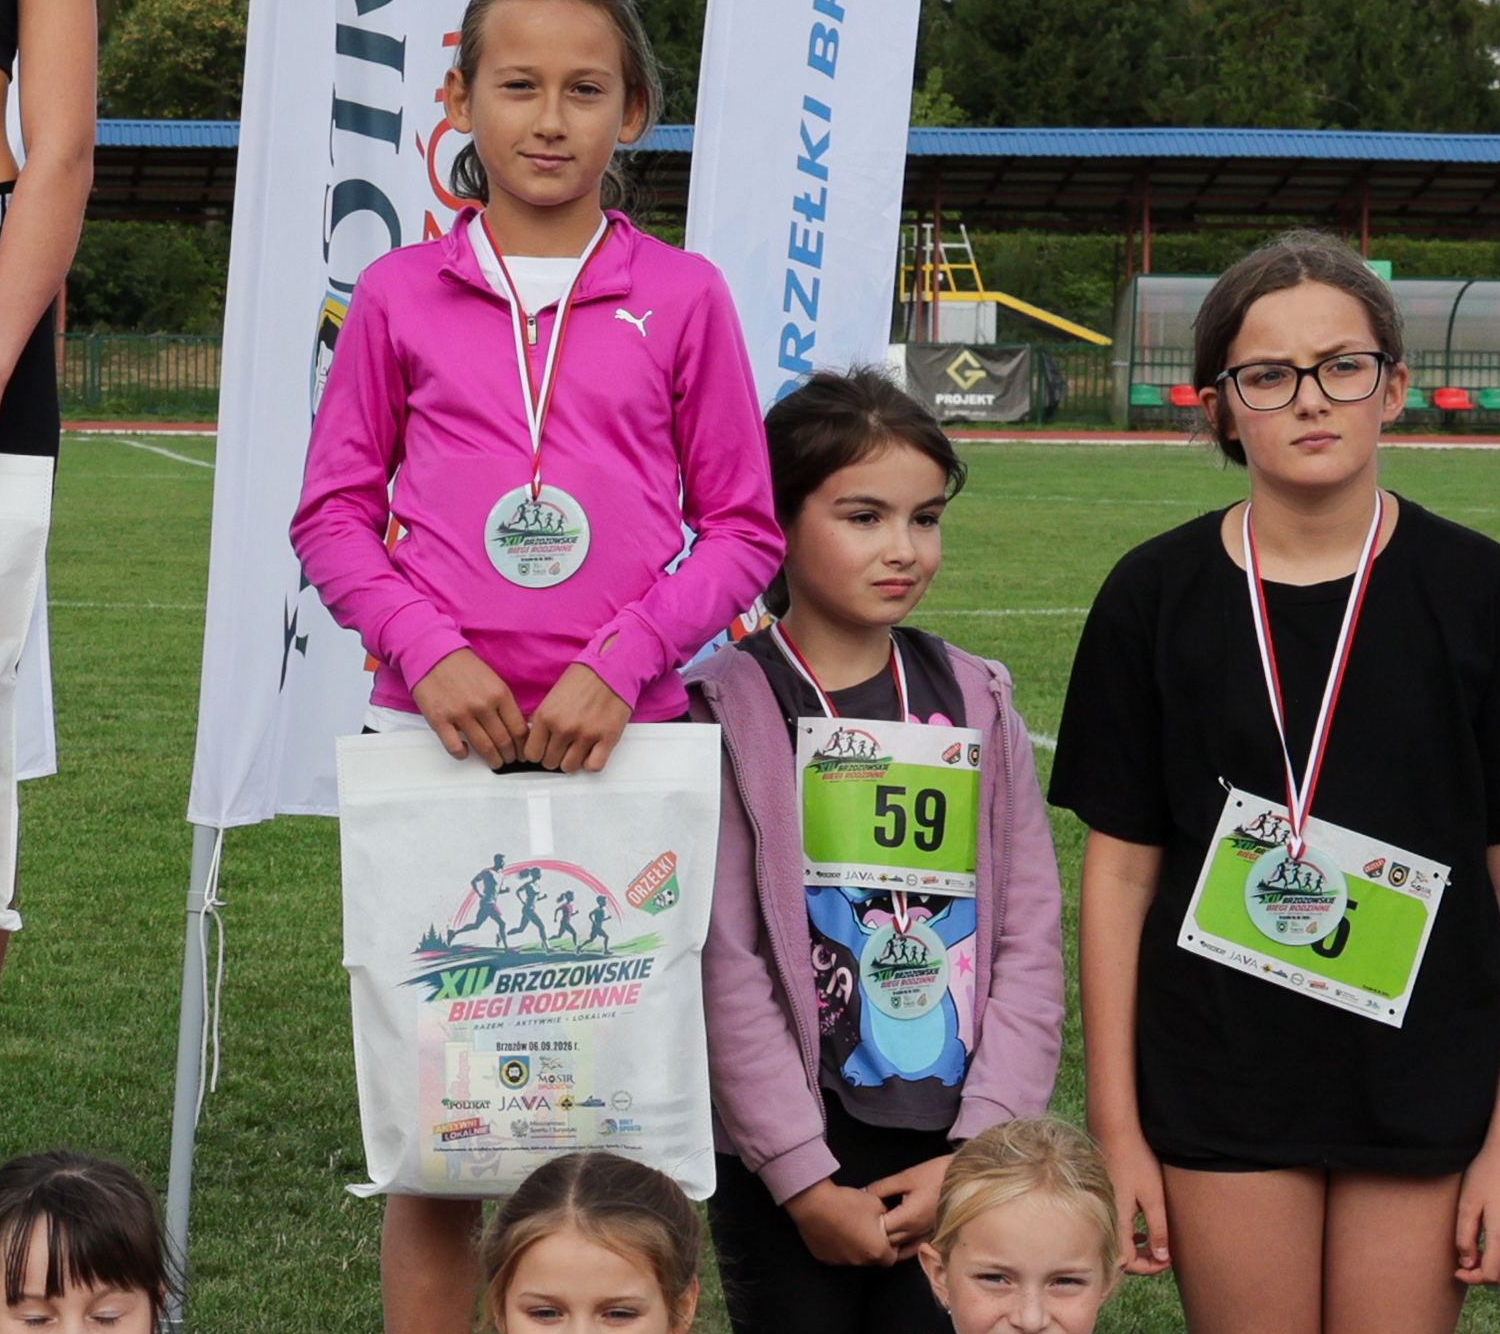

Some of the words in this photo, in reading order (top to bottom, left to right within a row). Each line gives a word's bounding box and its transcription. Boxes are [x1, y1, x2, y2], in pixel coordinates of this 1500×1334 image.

[777, 95, 832, 382] RZEŁKI
[935, 393, 995, 406] PROJEKT
[874, 784, 947, 852] 59
[627, 855, 675, 905] ORZEŁKI
[844, 871, 875, 882] JAVA
[1228, 951, 1259, 970] JAVA
[433, 966, 491, 1002] XII
[494, 957, 655, 995] BRZOZOWSKIE
[447, 997, 512, 1022] BIEGI
[516, 983, 643, 1016] RODZINNE
[473, 1022, 504, 1031] RAZEM
[515, 1017, 561, 1027] AKTYWNIE
[573, 1011, 617, 1022] LOKALNIE
[496, 1041, 527, 1052] Brzozów
[498, 1096, 551, 1111] JAVA
